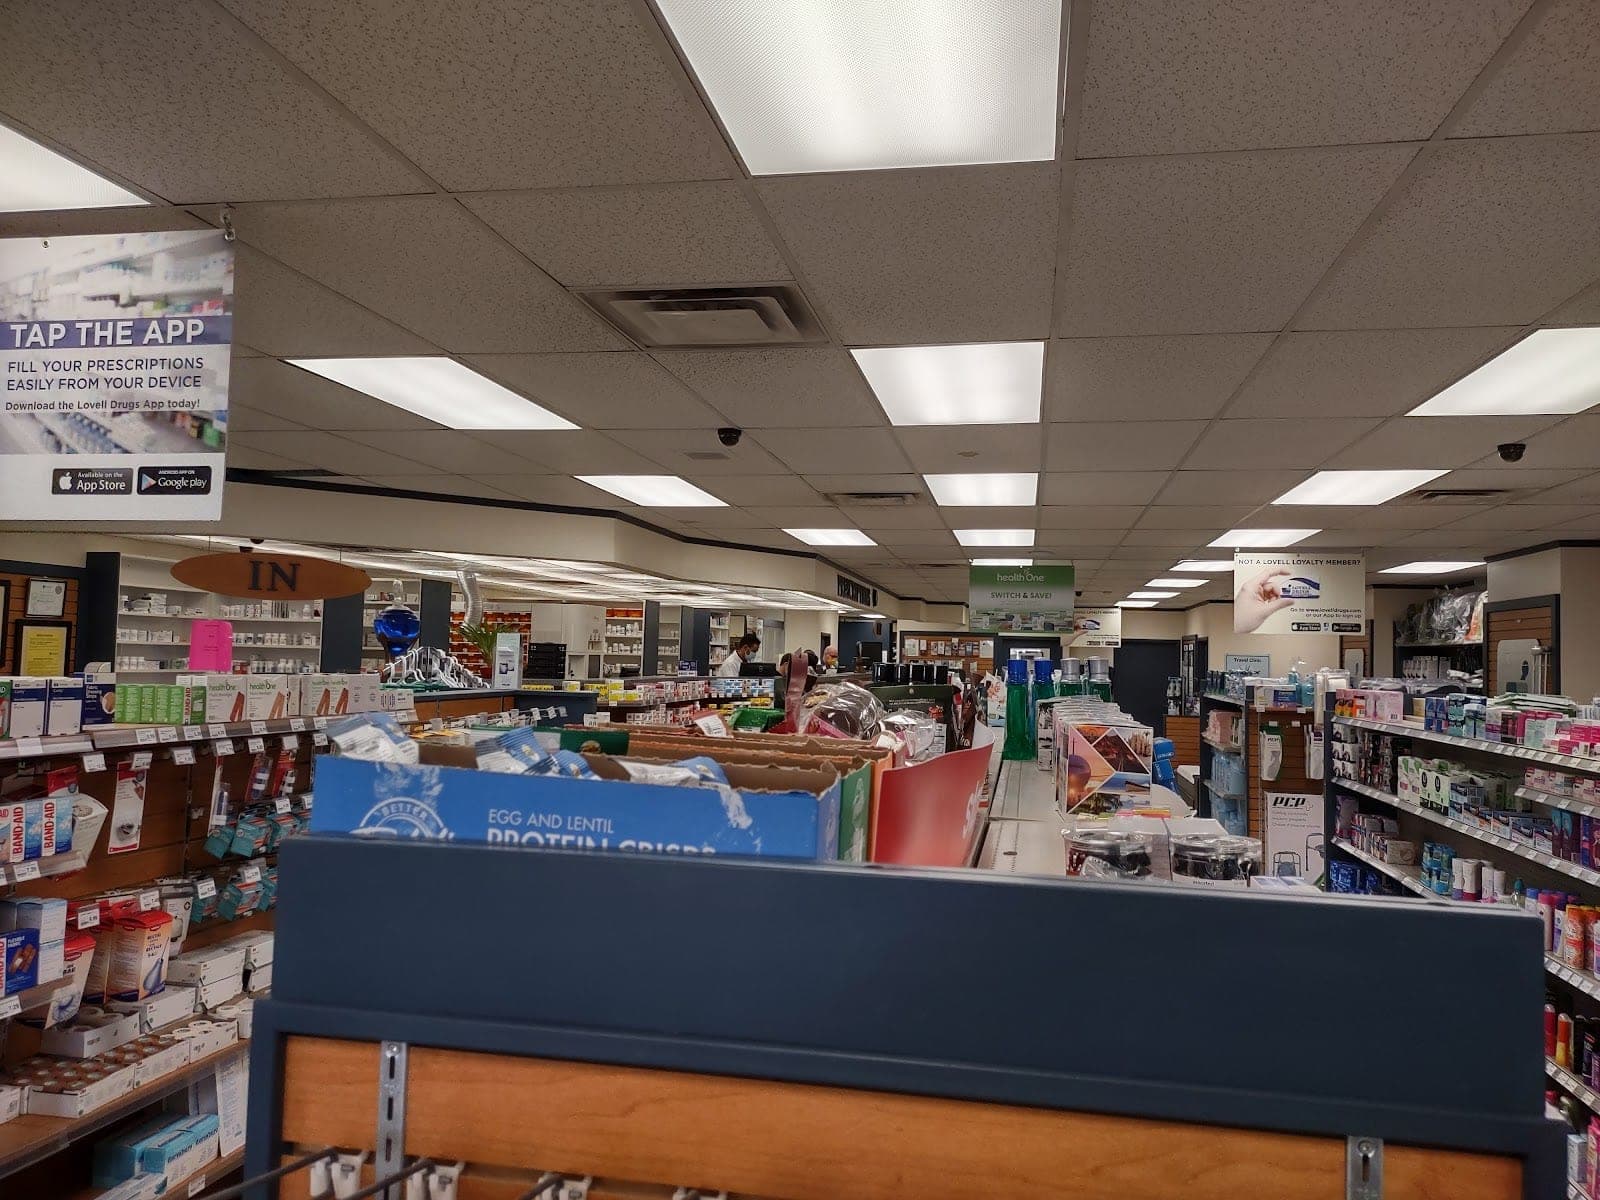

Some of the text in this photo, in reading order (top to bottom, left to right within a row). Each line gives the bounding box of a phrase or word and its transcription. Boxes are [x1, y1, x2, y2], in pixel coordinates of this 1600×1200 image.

[10, 318, 205, 348] TAP THE APP
[8, 357, 204, 373] FILL YOUR PRESCRIPTIONS
[7, 375, 201, 391] EASILY FROM YOUR DEVICE
[5, 398, 201, 411] Download the Lovell Drugs App today!
[76, 480, 126, 493] App Store
[158, 477, 208, 490] Google play
[248, 560, 301, 592] IN
[1030, 592, 1052, 600] SAVE!
[382, 803, 428, 821] BETTER
[488, 808, 614, 834] EGG AND LENTIL
